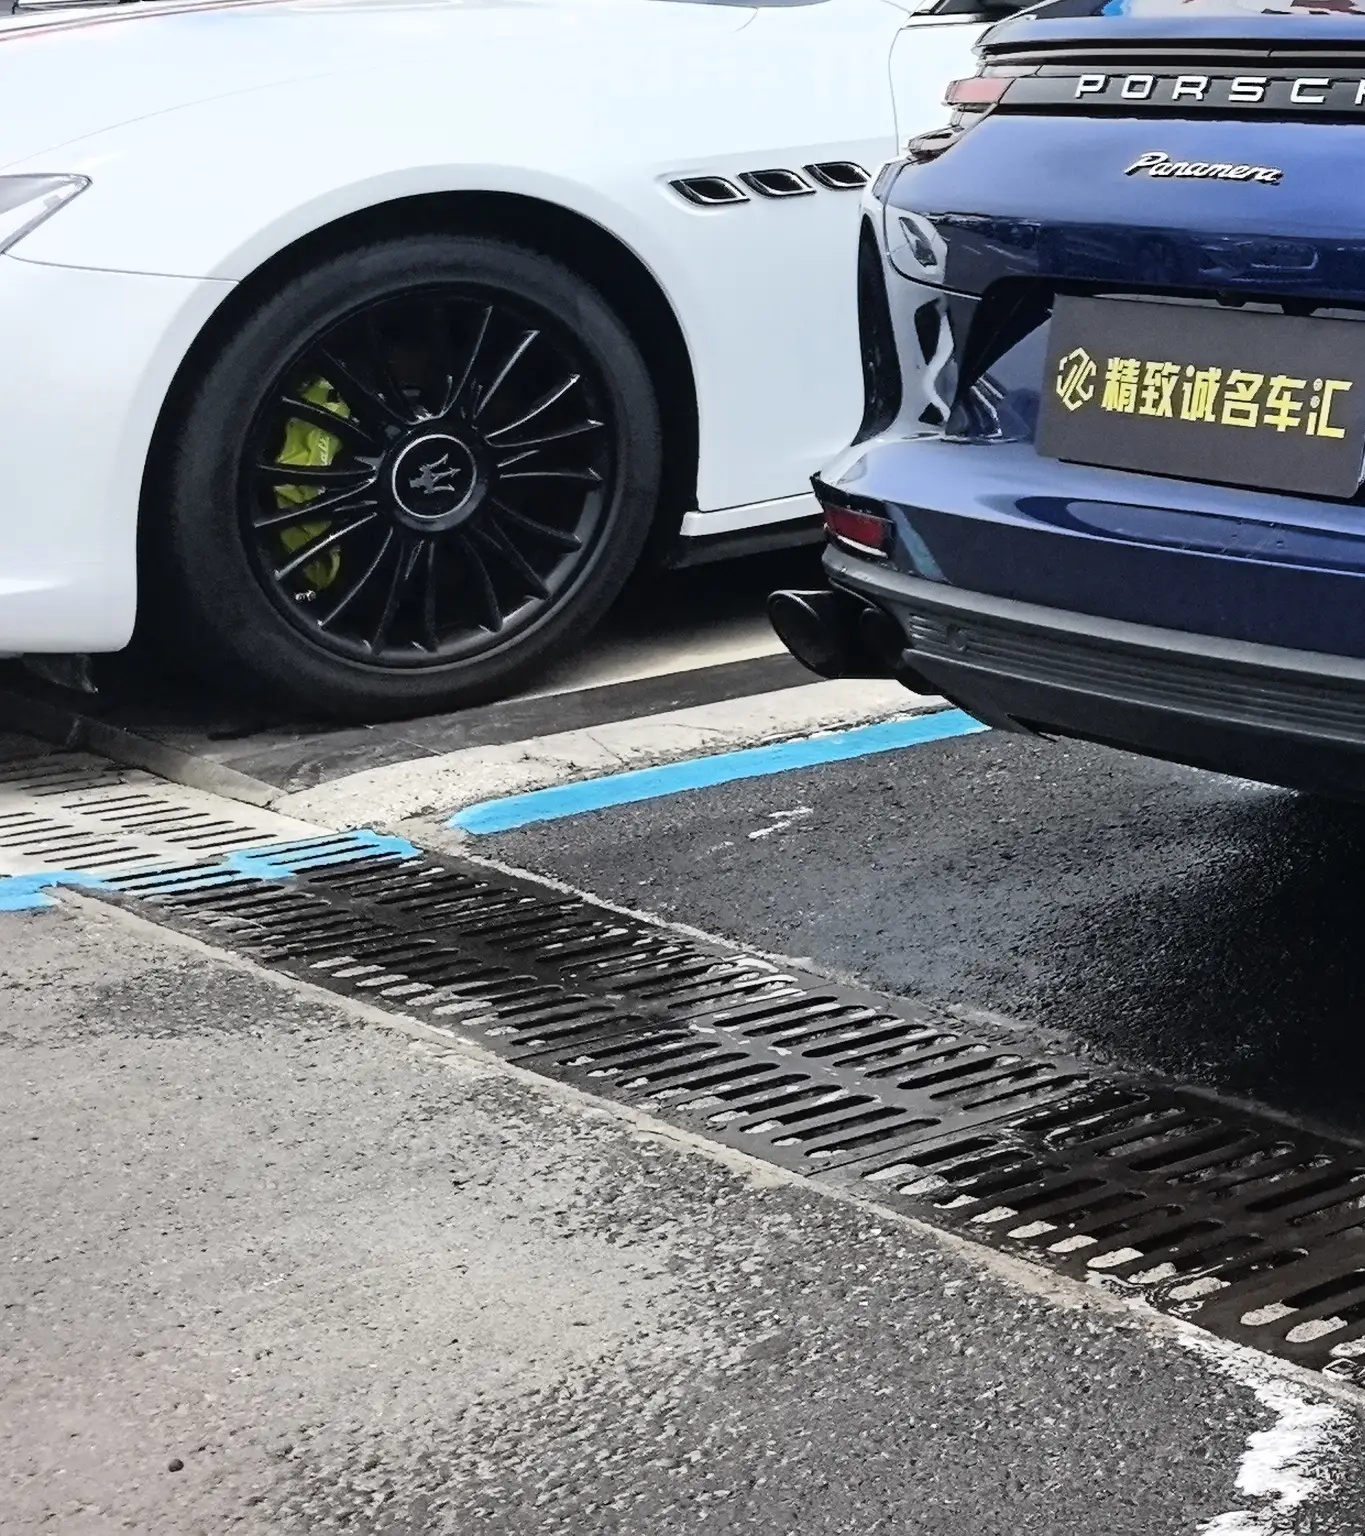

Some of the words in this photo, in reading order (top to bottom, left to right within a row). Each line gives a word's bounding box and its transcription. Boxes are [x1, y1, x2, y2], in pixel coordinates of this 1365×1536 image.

[1124, 151, 1284, 184] Panamera
[1101, 356, 1353, 439] 精致诚名车汇
